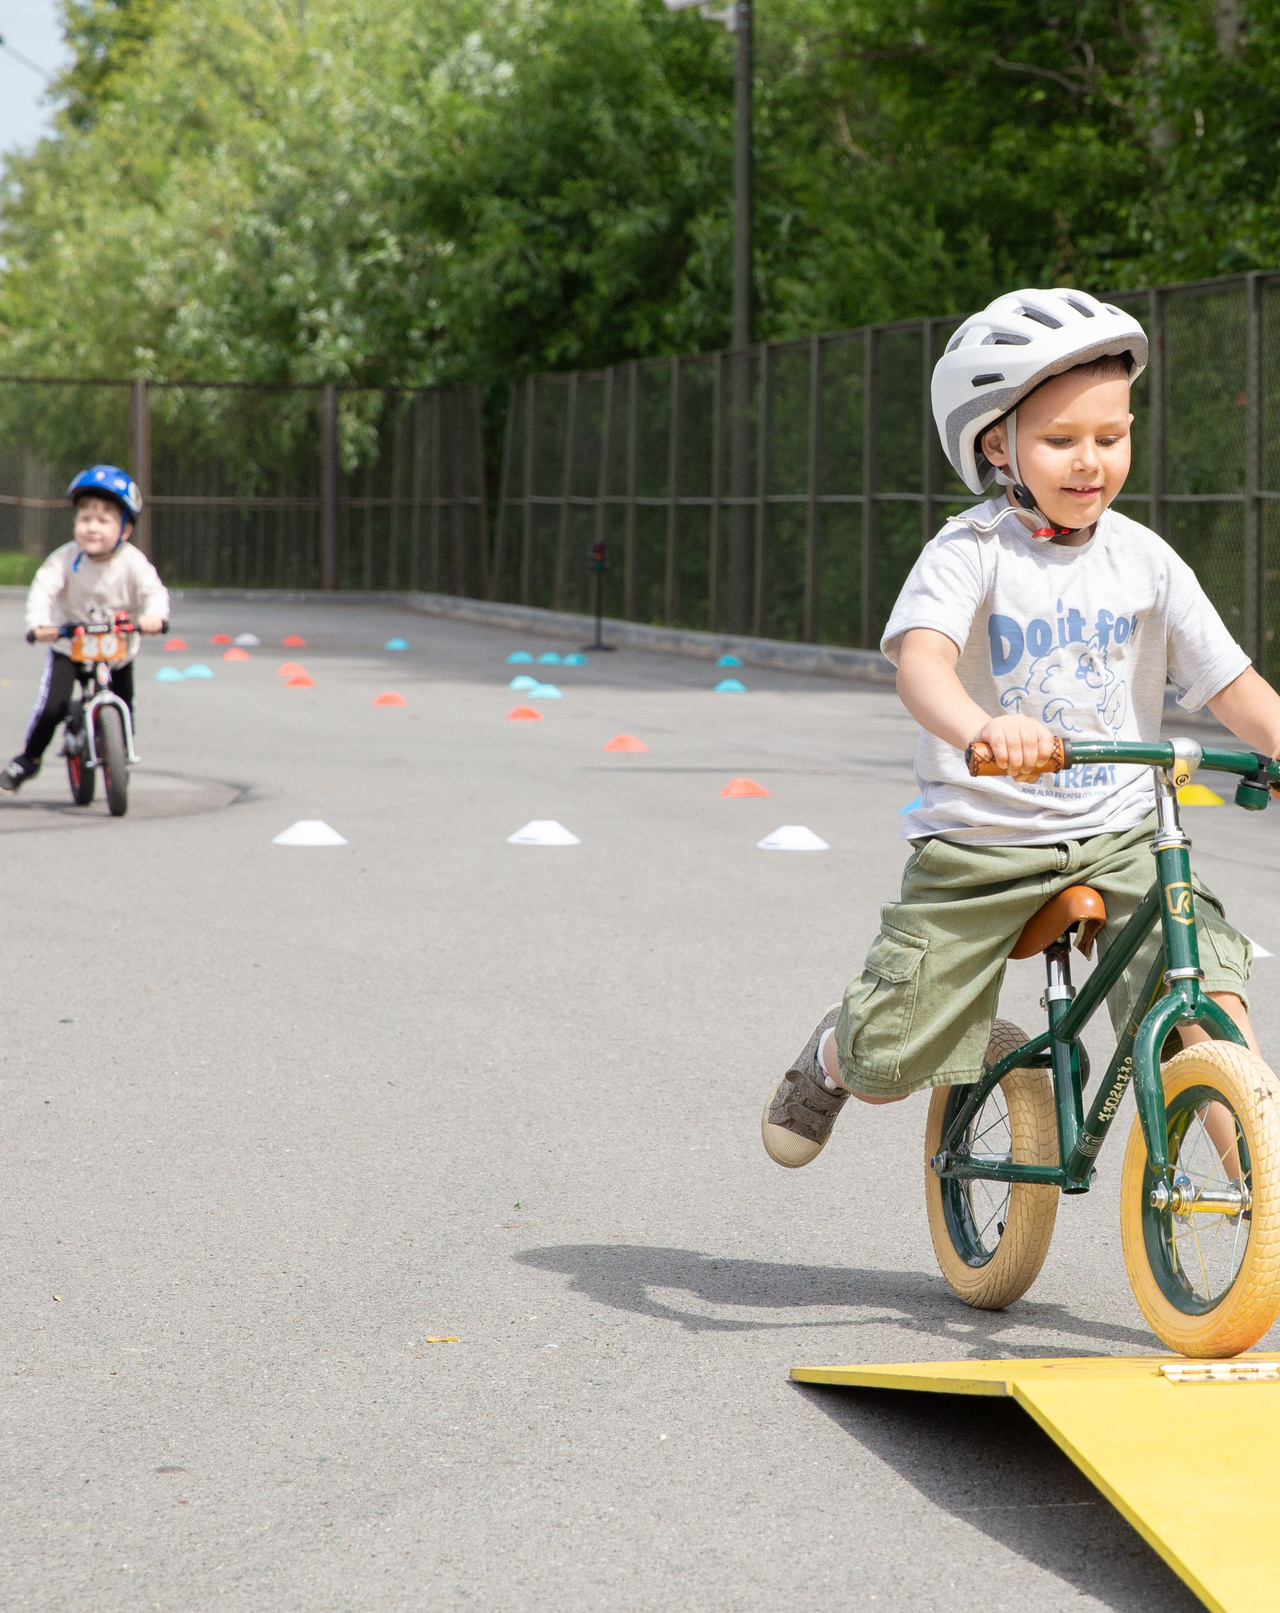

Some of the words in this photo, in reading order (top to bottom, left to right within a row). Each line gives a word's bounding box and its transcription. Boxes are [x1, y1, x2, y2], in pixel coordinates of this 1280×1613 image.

[988, 613, 1053, 677] Do
[1056, 598, 1087, 649] it
[1053, 764, 1117, 789] TREAT
[1021, 787, 1036, 796] AND
[1037, 789, 1054, 797] ALSO
[1054, 791, 1081, 799] BECAUSE
